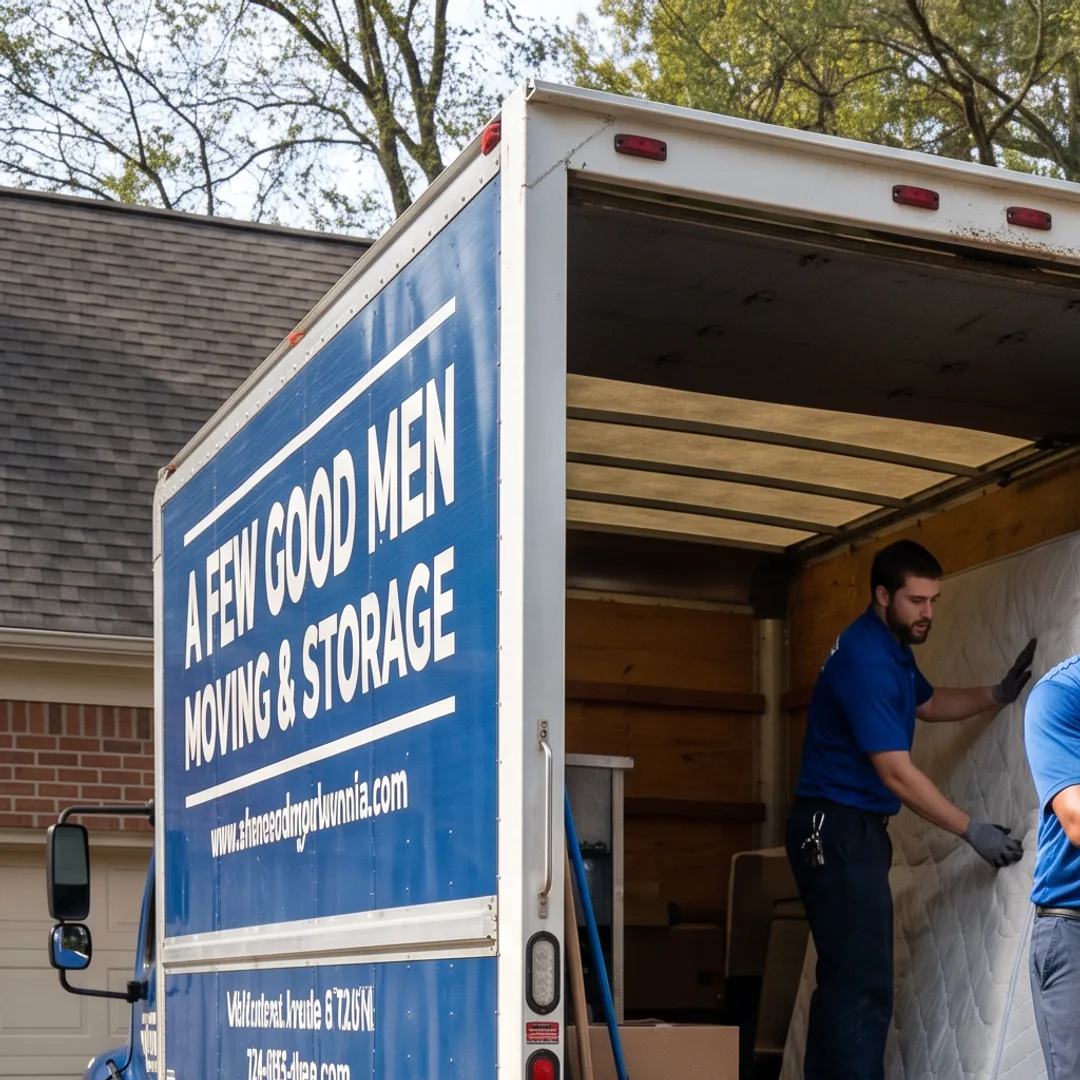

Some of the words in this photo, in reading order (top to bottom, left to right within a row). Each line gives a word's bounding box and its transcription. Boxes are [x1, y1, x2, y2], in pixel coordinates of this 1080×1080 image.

[185, 570, 204, 670] A
[206, 518, 259, 657] FEW
[265, 449, 356, 616] GOOD
[367, 363, 455, 554] MEN
[185, 652, 271, 771] MOVING
[277, 639, 295, 731] &
[302, 546, 455, 720] STORAGE
